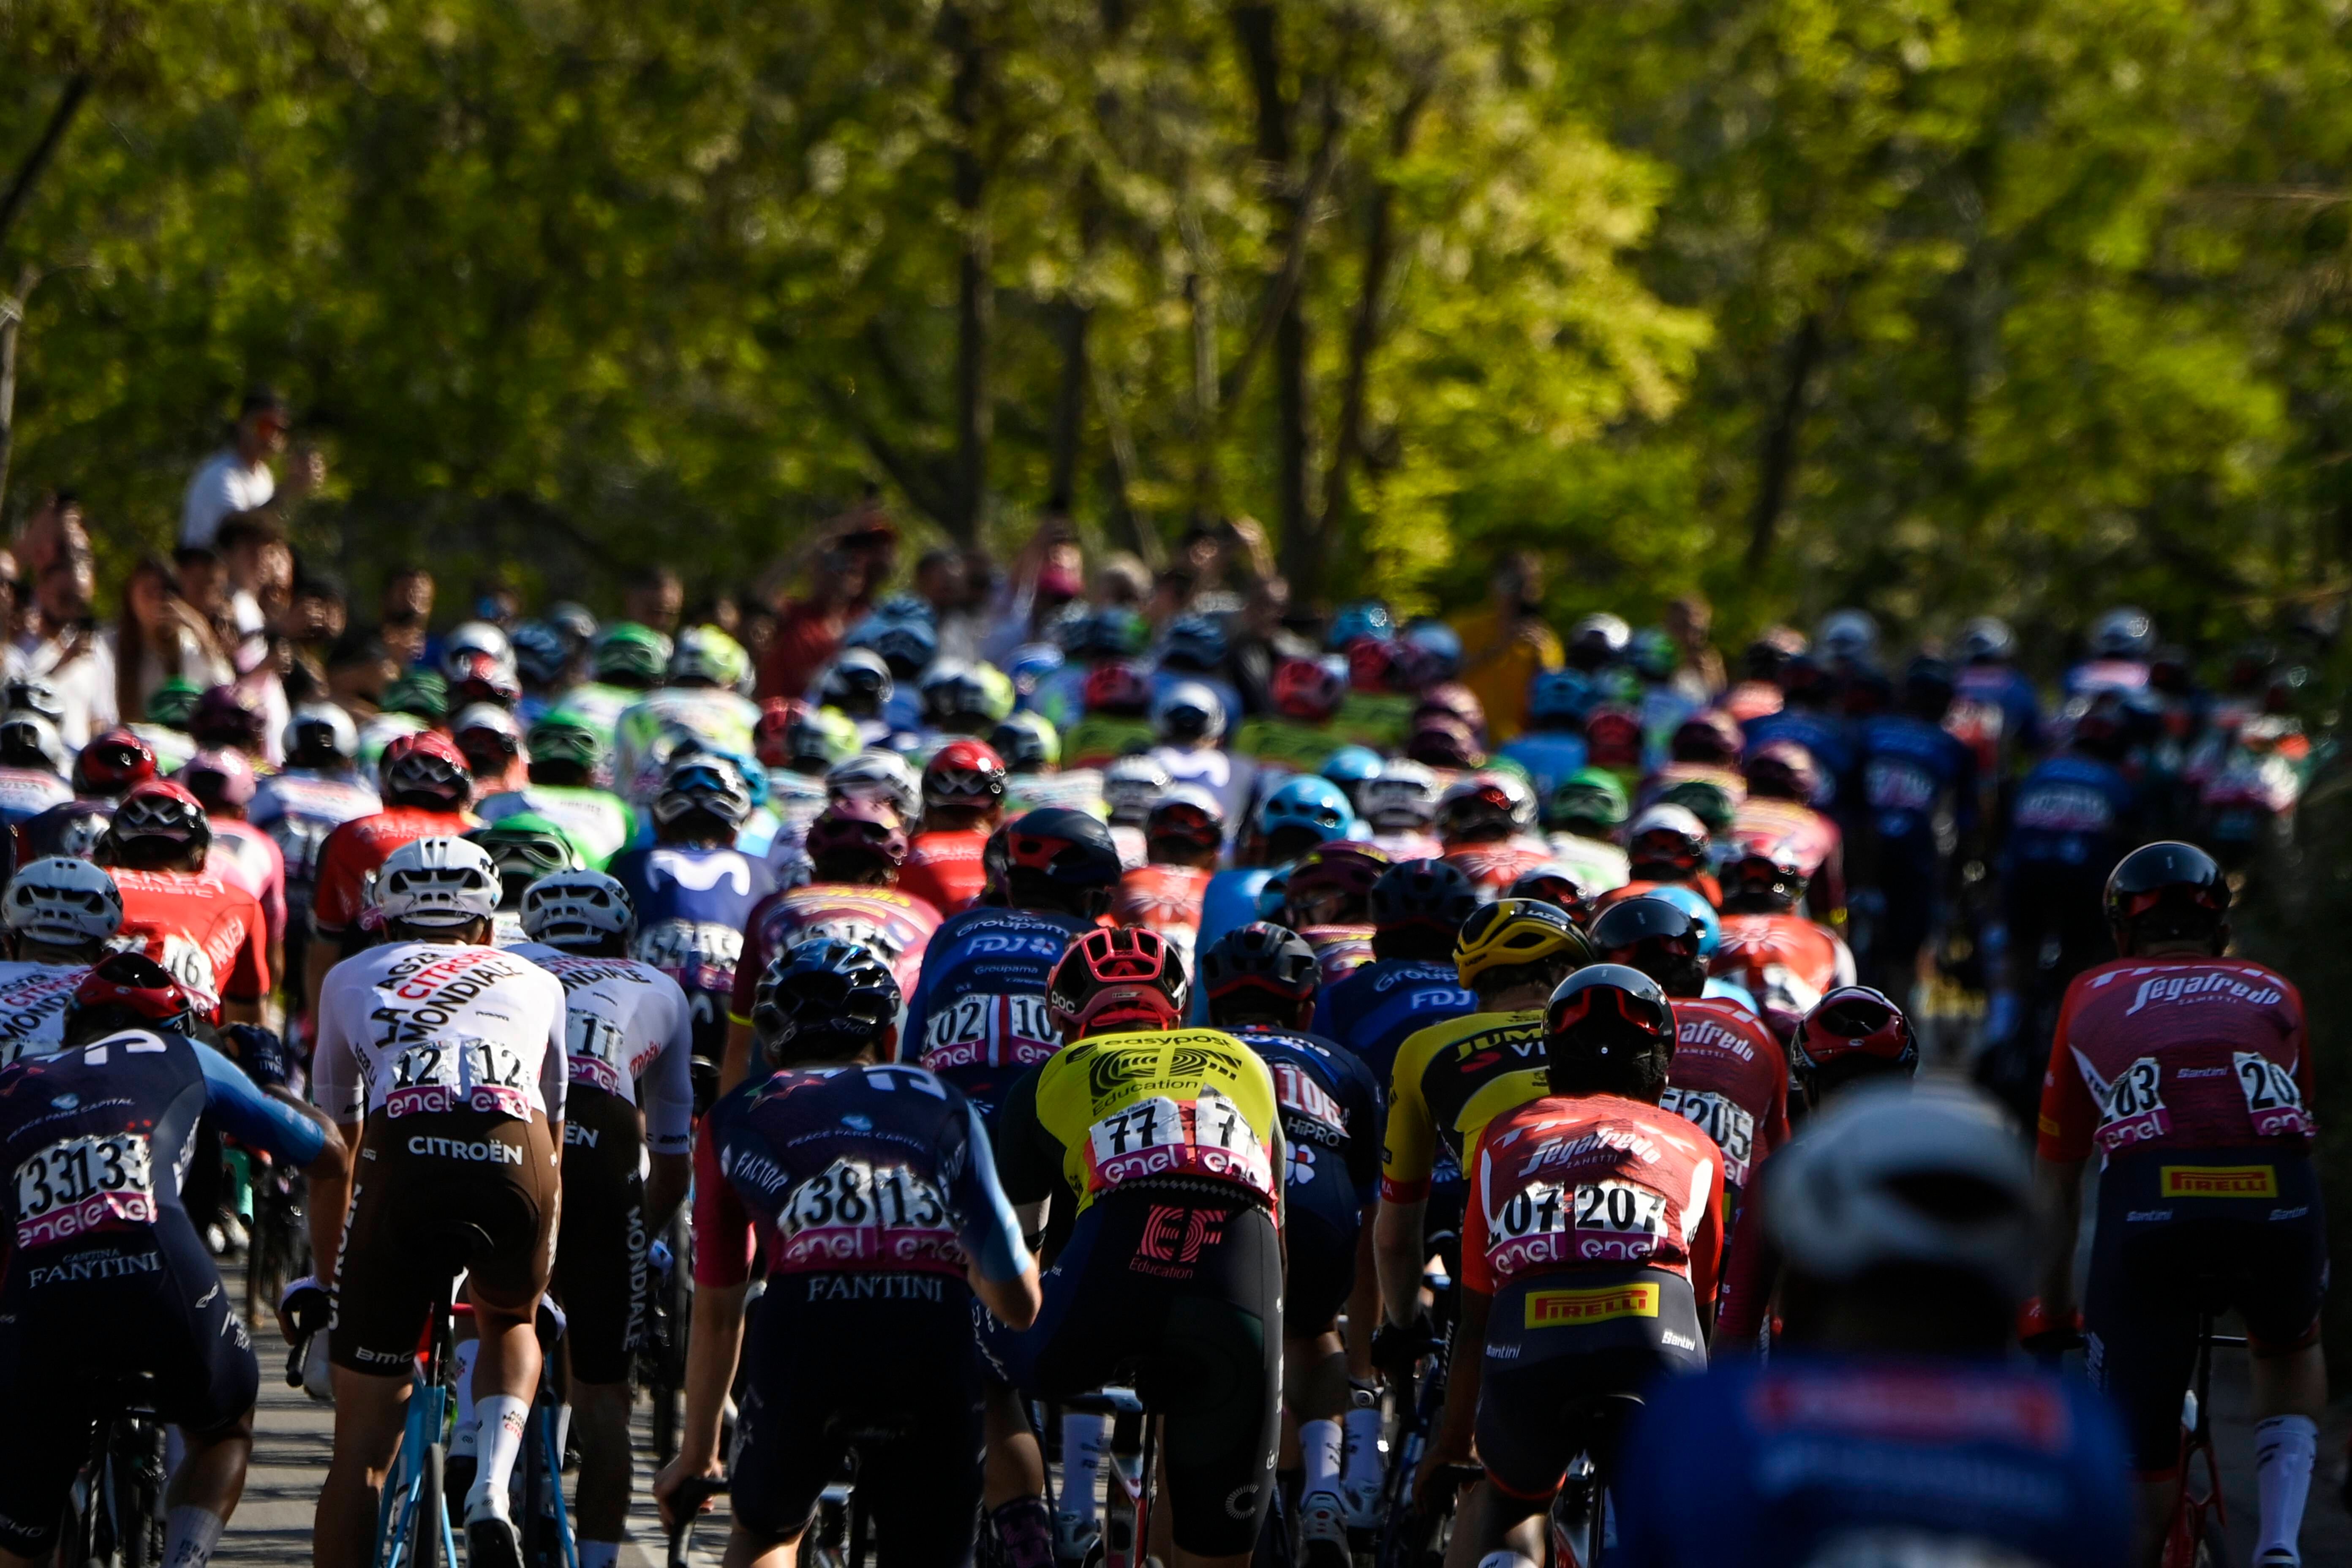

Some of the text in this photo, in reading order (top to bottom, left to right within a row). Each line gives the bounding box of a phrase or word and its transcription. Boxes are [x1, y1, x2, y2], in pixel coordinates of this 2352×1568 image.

[957, 919, 1070, 939] Groupam
[966, 936, 1027, 956] FDJ
[1373, 969, 1459, 992] Group
[2126, 972, 2282, 1016] Segafredo
[399, 961, 524, 1043] MONDIALE
[1411, 988, 1472, 1010] FDJ
[931, 999, 1058, 1048] 02 10
[1677, 1019, 1755, 1062] afredo
[1104, 1035, 1236, 1051] easypost
[1455, 1027, 1542, 1063] JUM
[394, 1048, 442, 1090] 12
[387, 1086, 454, 1119] enel
[1092, 1079, 1198, 1116] Education
[1281, 1069, 1342, 1129] 106
[2110, 1064, 2155, 1117] 03
[2241, 1062, 2297, 1110] 20
[1104, 1105, 1158, 1156] 77
[1285, 1116, 1341, 1147] HiPRO
[1686, 1097, 1751, 1162] 205
[408, 1135, 523, 1165] CITROËN
[1104, 1144, 1180, 1184] enel
[1518, 1127, 1662, 1178] Segafredo
[1566, 1154, 1618, 1170] ZANETTI
[734, 1149, 790, 1195] FACTOR
[2171, 1171, 2267, 1192] PIRELLI
[28, 1249, 164, 1290] FANTINI
[1129, 1257, 1193, 1279] Education
[806, 1275, 944, 1303] FANTINI
[1535, 1290, 1648, 1320] PIRELLI
[1486, 1344, 1521, 1359] Santini
[1662, 1330, 1696, 1351] Santini
